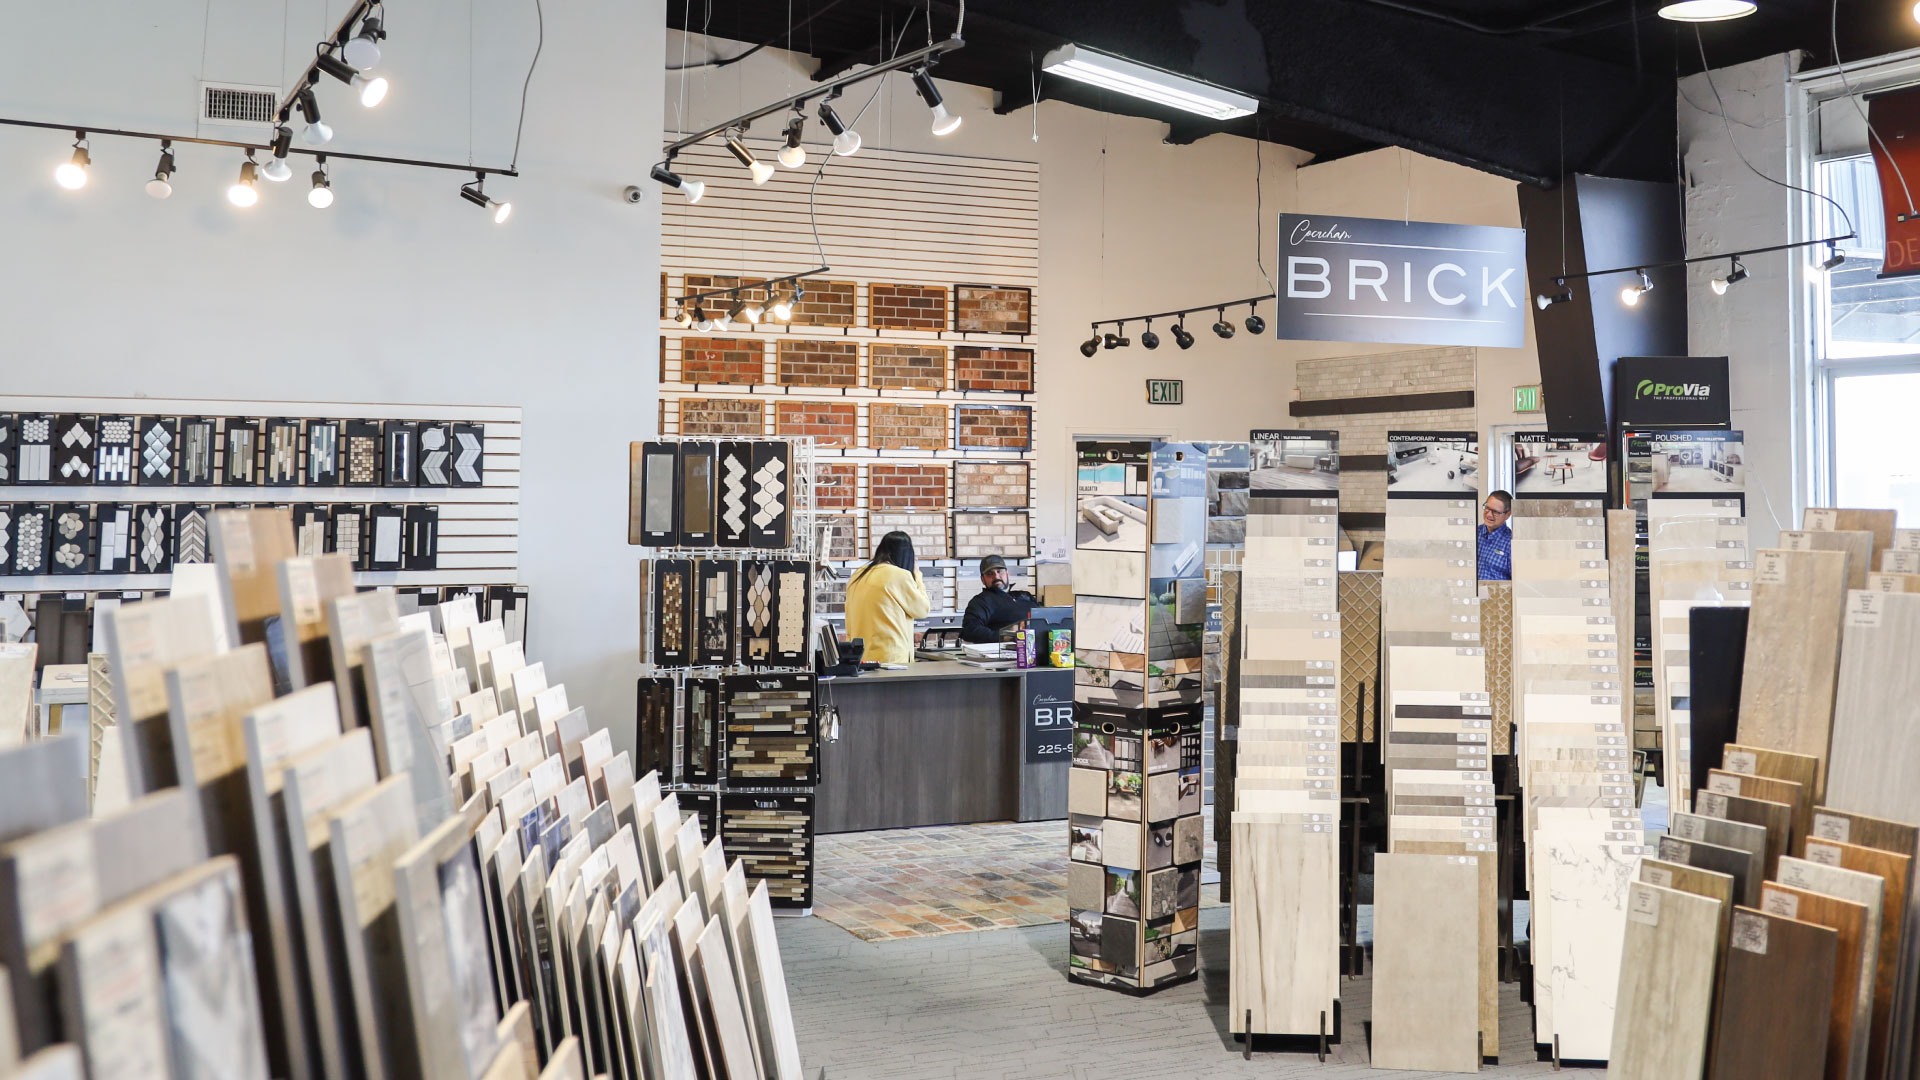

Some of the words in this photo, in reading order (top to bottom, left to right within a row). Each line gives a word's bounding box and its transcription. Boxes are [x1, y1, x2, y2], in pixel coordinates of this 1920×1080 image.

[1287, 255, 1517, 308] BRICK
[1152, 382, 1179, 401] EXIT
[1654, 383, 1711, 396] ProVia
[1517, 389, 1536, 410] EXIT
[1253, 432, 1280, 440] LINEAR
[1520, 434, 1546, 443] MATTE
[1655, 434, 1693, 442] POLISHED
